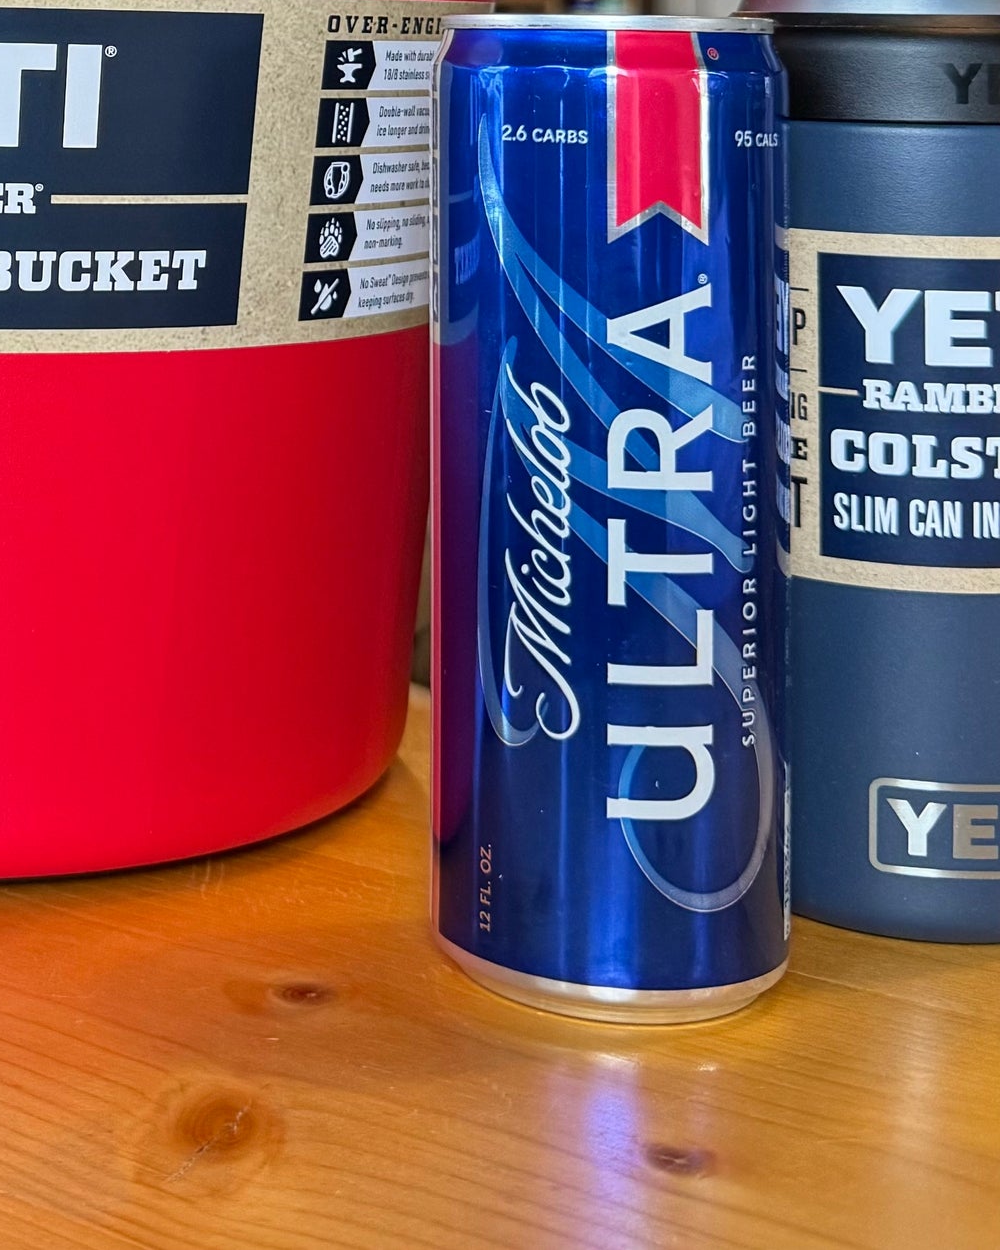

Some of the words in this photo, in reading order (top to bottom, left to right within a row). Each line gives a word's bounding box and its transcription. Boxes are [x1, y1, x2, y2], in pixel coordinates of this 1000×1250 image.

[327, 14, 444, 35] OVER-ENGI
[385, 50, 402, 62] Made
[404, 50, 416, 62] with
[384, 68, 397, 81] 18/8
[399, 68, 425, 81] stainless
[379, 105, 415, 118] Double-wall
[377, 124, 386, 137] ice
[387, 124, 407, 139] longer
[408, 123, 418, 136] and
[501, 124, 527, 143] 2.6
[532, 128, 588, 145] CARBS
[734, 130, 753, 147] 95
[755, 133, 778, 147] CALS
[372, 160, 408, 175] Dishwasher
[370, 181, 389, 193] needs
[390, 181, 405, 192] more
[406, 179, 418, 190] work
[366, 219, 375, 231] No
[402, 217, 409, 227] no
[360, 278, 369, 290] No
[391, 273, 409, 287] Design
[358, 295, 382, 310] keeping
[383, 292, 405, 305] surfaces
[836, 285, 1000, 368] YE
[742, 354, 757, 438] BEER
[862, 378, 1000, 415] RAMB
[742, 458, 757, 556] LIGHT
[833, 491, 900, 537] SLIM
[908, 498, 963, 540] CAN
[503, 361, 582, 741] Michelob
[742, 578, 758, 747] SUPERIOR
[886, 798, 999, 860] YE
[479, 843, 492, 874] OZ.
[479, 880, 491, 906] FL.
[479, 910, 491, 933] 12
